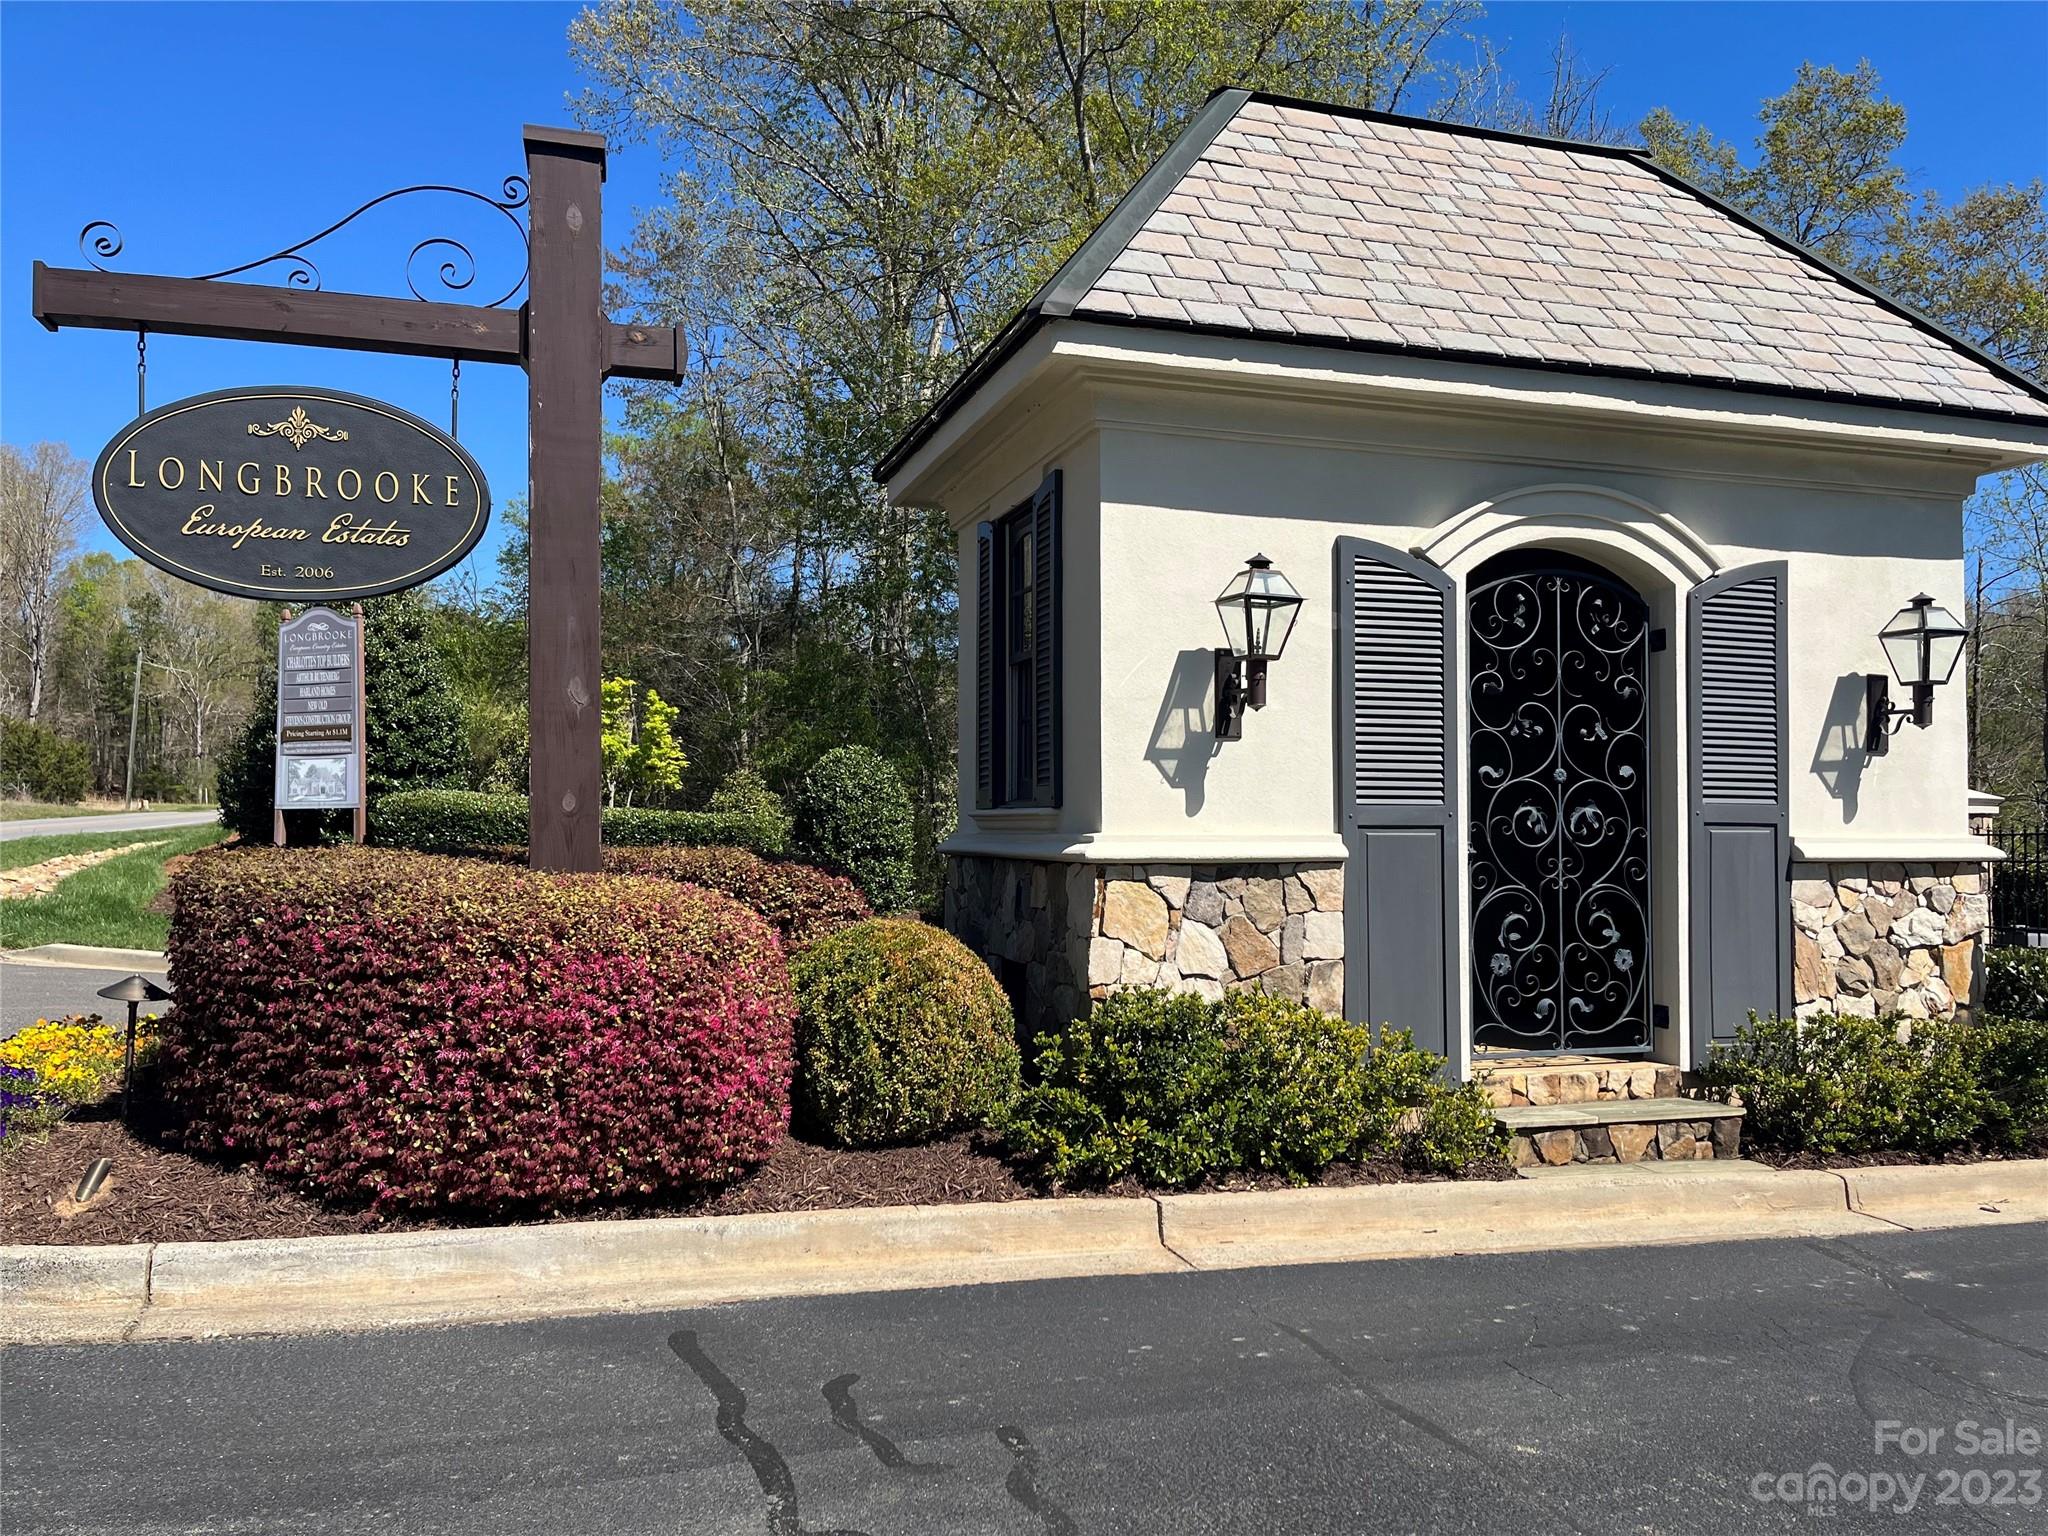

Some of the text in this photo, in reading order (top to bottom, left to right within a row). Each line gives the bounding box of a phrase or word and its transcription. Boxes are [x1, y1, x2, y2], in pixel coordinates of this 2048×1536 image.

[127, 449, 461, 507] LONGBROOKE
[180, 504, 411, 550] European Estates
[260, 564, 334, 580] Est. 2006
[284, 629, 353, 644] LONGBROOKE
[286, 729, 304, 738] Pricing
[305, 729, 325, 737] Starting
